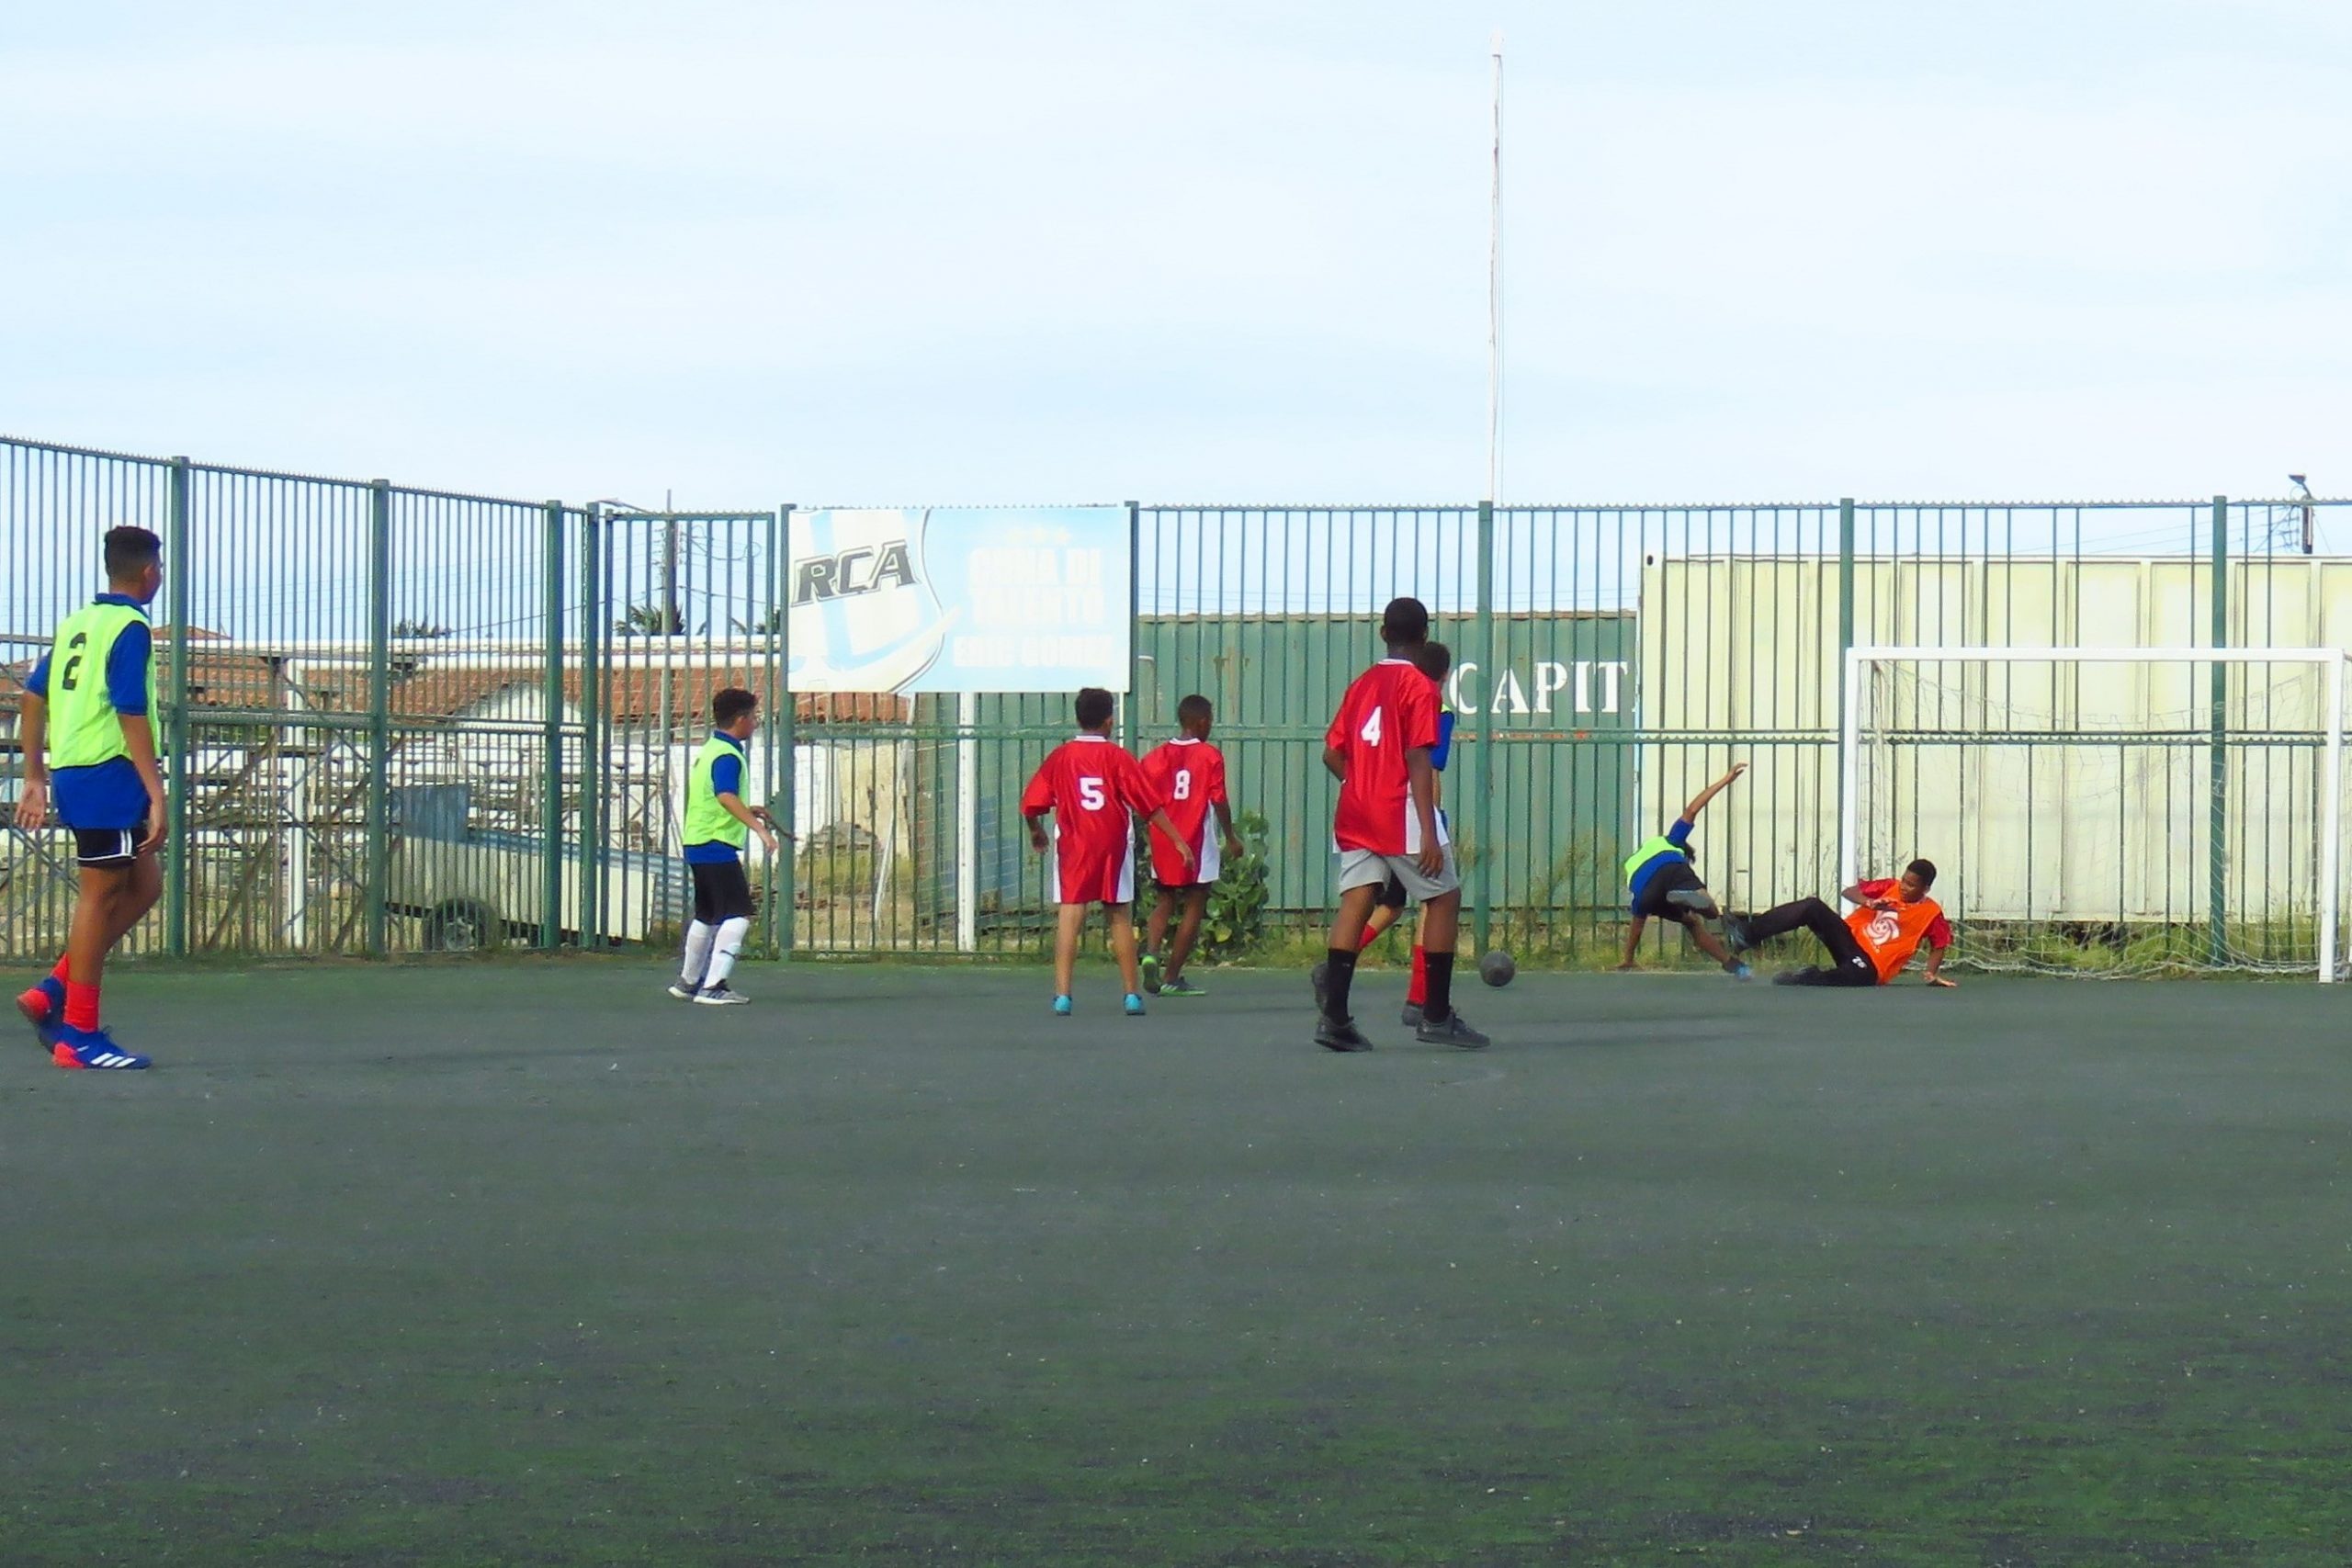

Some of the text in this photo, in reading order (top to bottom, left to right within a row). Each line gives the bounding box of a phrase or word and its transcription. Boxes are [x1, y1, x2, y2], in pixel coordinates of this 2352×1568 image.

[791, 539, 921, 607] RCA
[62, 632, 87, 691] 2
[1449, 661, 1638, 714] CAPIT
[1361, 705, 1382, 747] 4
[1080, 776, 1105, 811] 5
[1173, 769, 1191, 801] 8
